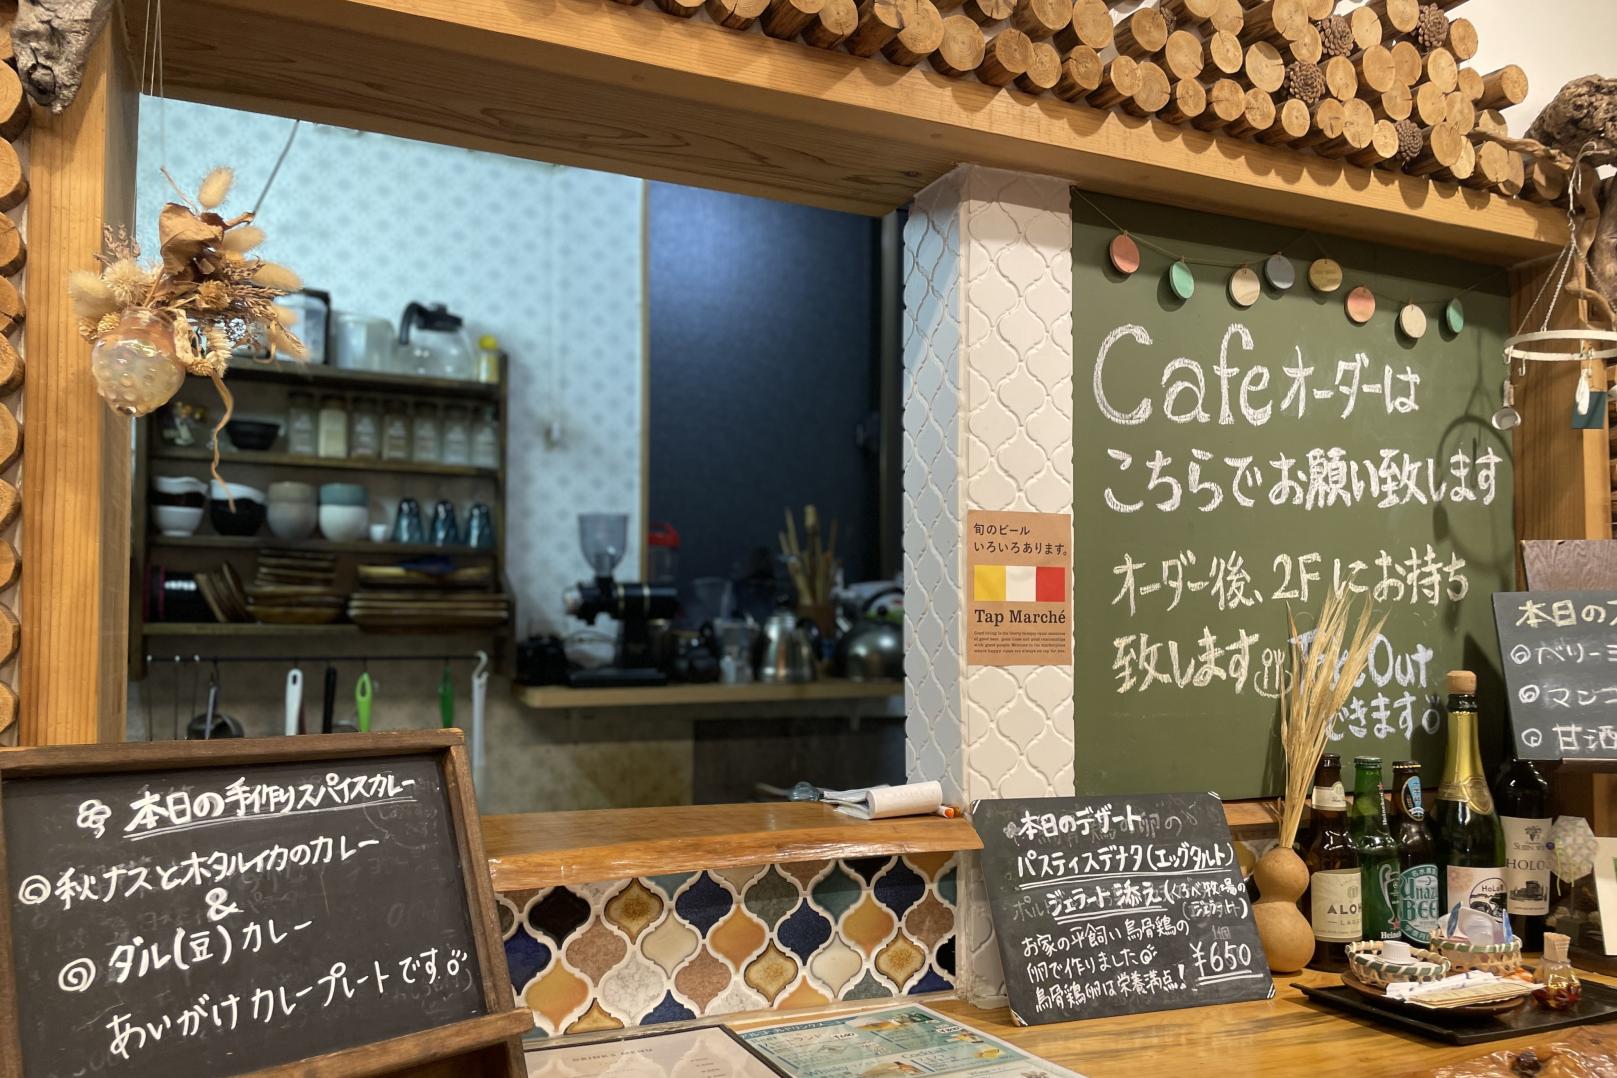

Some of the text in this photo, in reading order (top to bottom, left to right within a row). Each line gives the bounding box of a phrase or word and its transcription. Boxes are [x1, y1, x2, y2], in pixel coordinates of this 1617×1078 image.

[1104, 447, 1503, 512] こちらでお願い致します
[973, 522, 1030, 536] 旬のビール
[974, 541, 1068, 556] いろいろあります。
[974, 608, 1066, 627] Tap Marché
[124, 773, 416, 831] 本日の手作りスパイスカレー
[1018, 803, 1142, 840] 本日のデザート
[1189, 941, 1251, 977] ¥650
